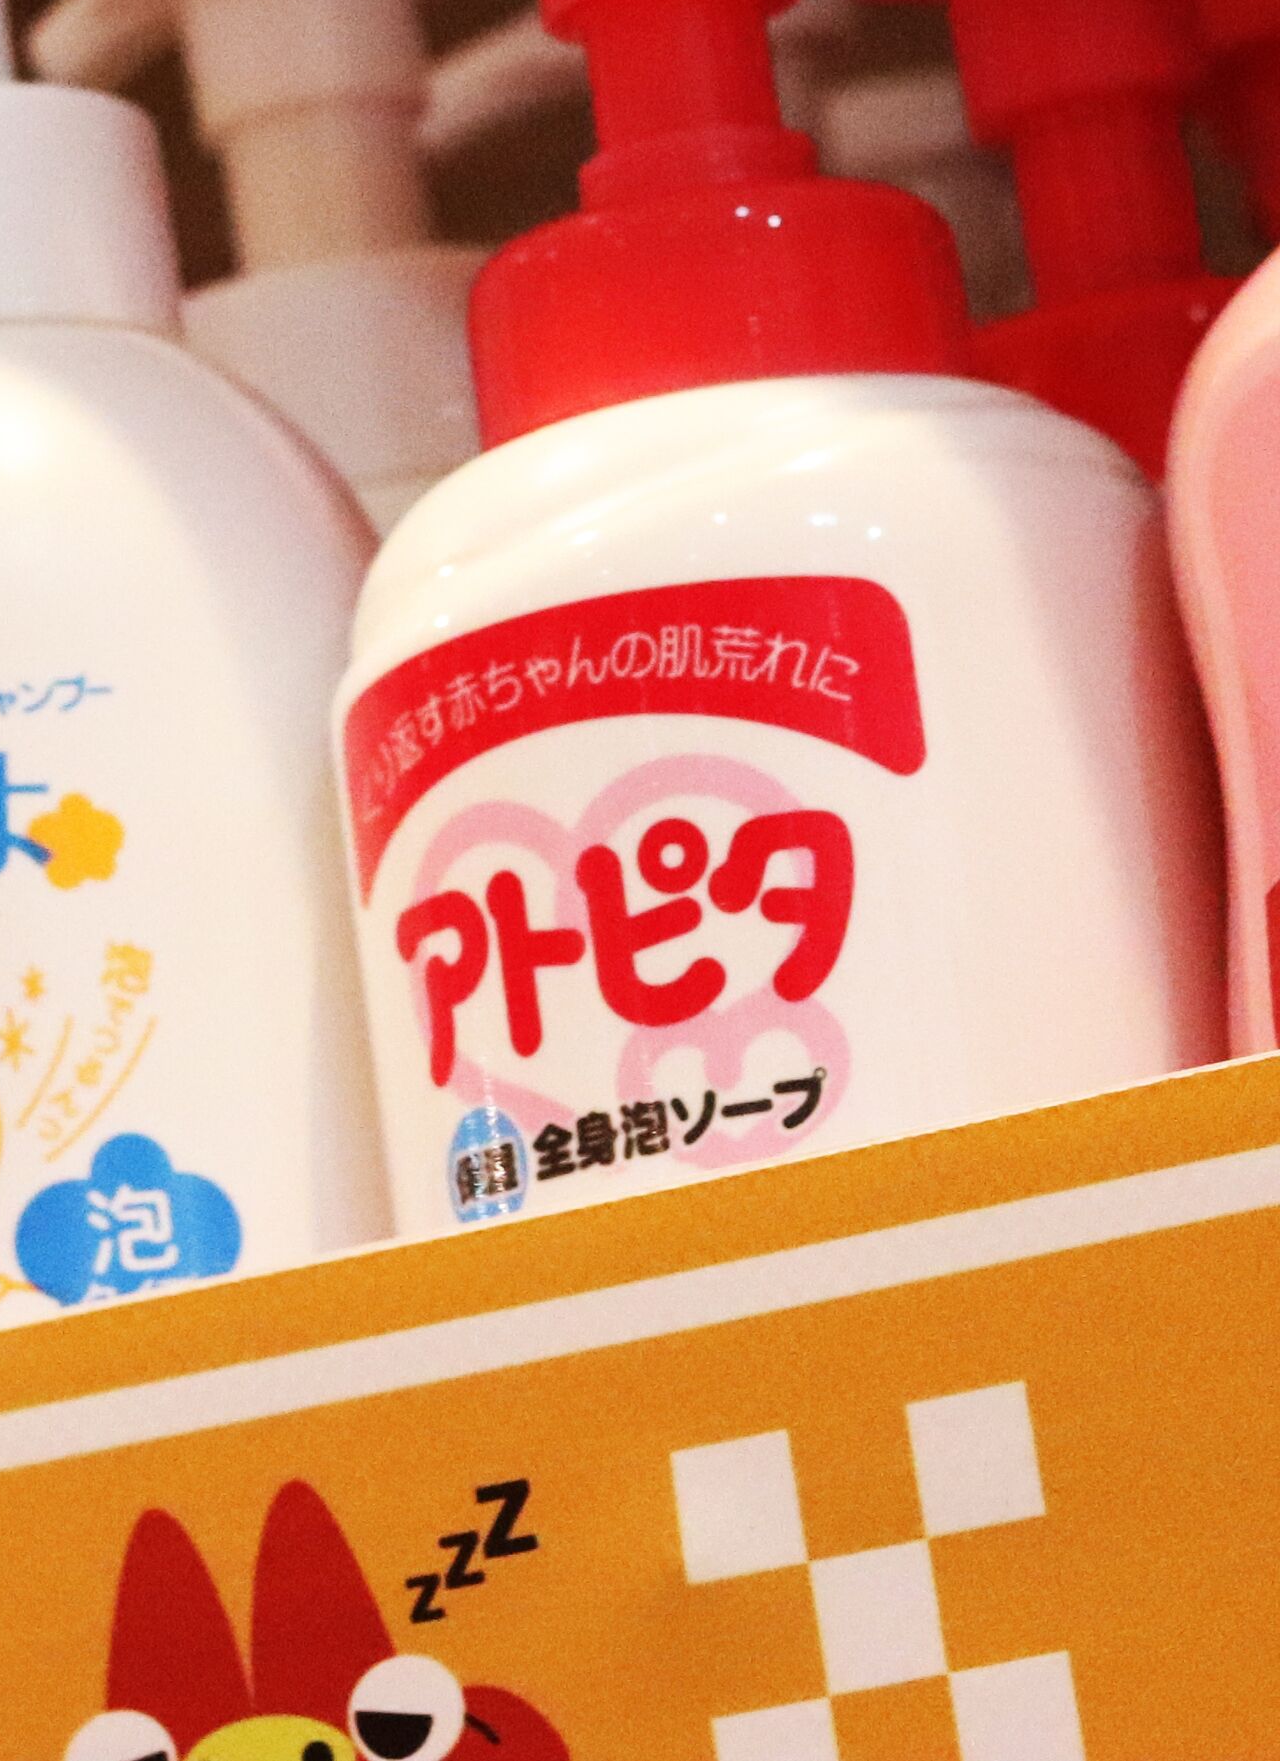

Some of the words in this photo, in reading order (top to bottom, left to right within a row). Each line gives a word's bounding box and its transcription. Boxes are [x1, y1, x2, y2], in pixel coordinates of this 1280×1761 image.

[396, 809, 854, 1088] アトピタ
[531, 1066, 827, 1182] 全身泡ソープ
[86, 1183, 180, 1276] 泡
